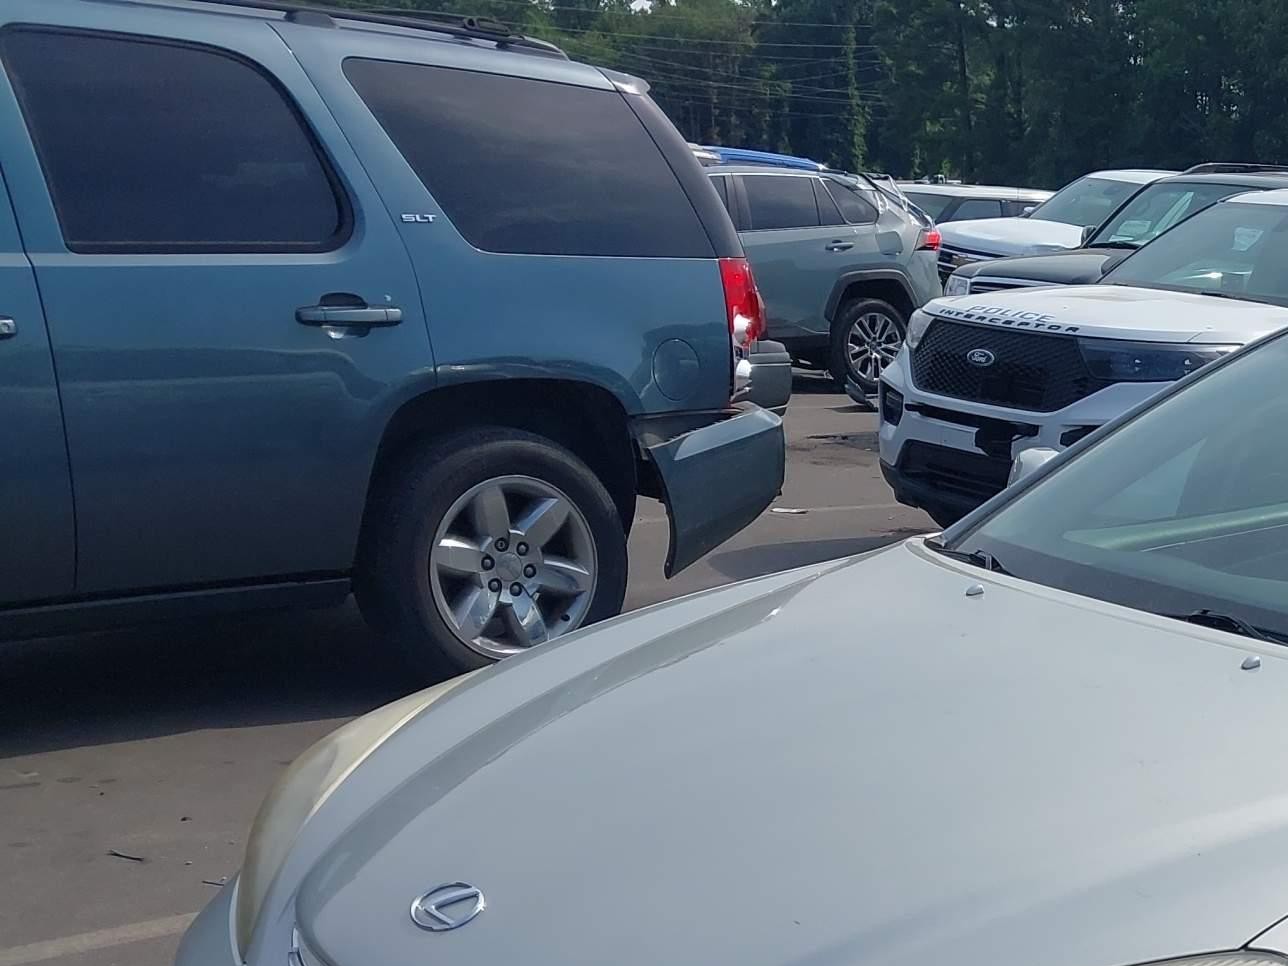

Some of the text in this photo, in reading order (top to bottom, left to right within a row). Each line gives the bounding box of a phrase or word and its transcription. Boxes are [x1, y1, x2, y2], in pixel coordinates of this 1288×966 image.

[401, 213, 437, 222] SLT
[939, 309, 1080, 333] INTERCEPTOR
[966, 305, 1057, 323] POLICE
